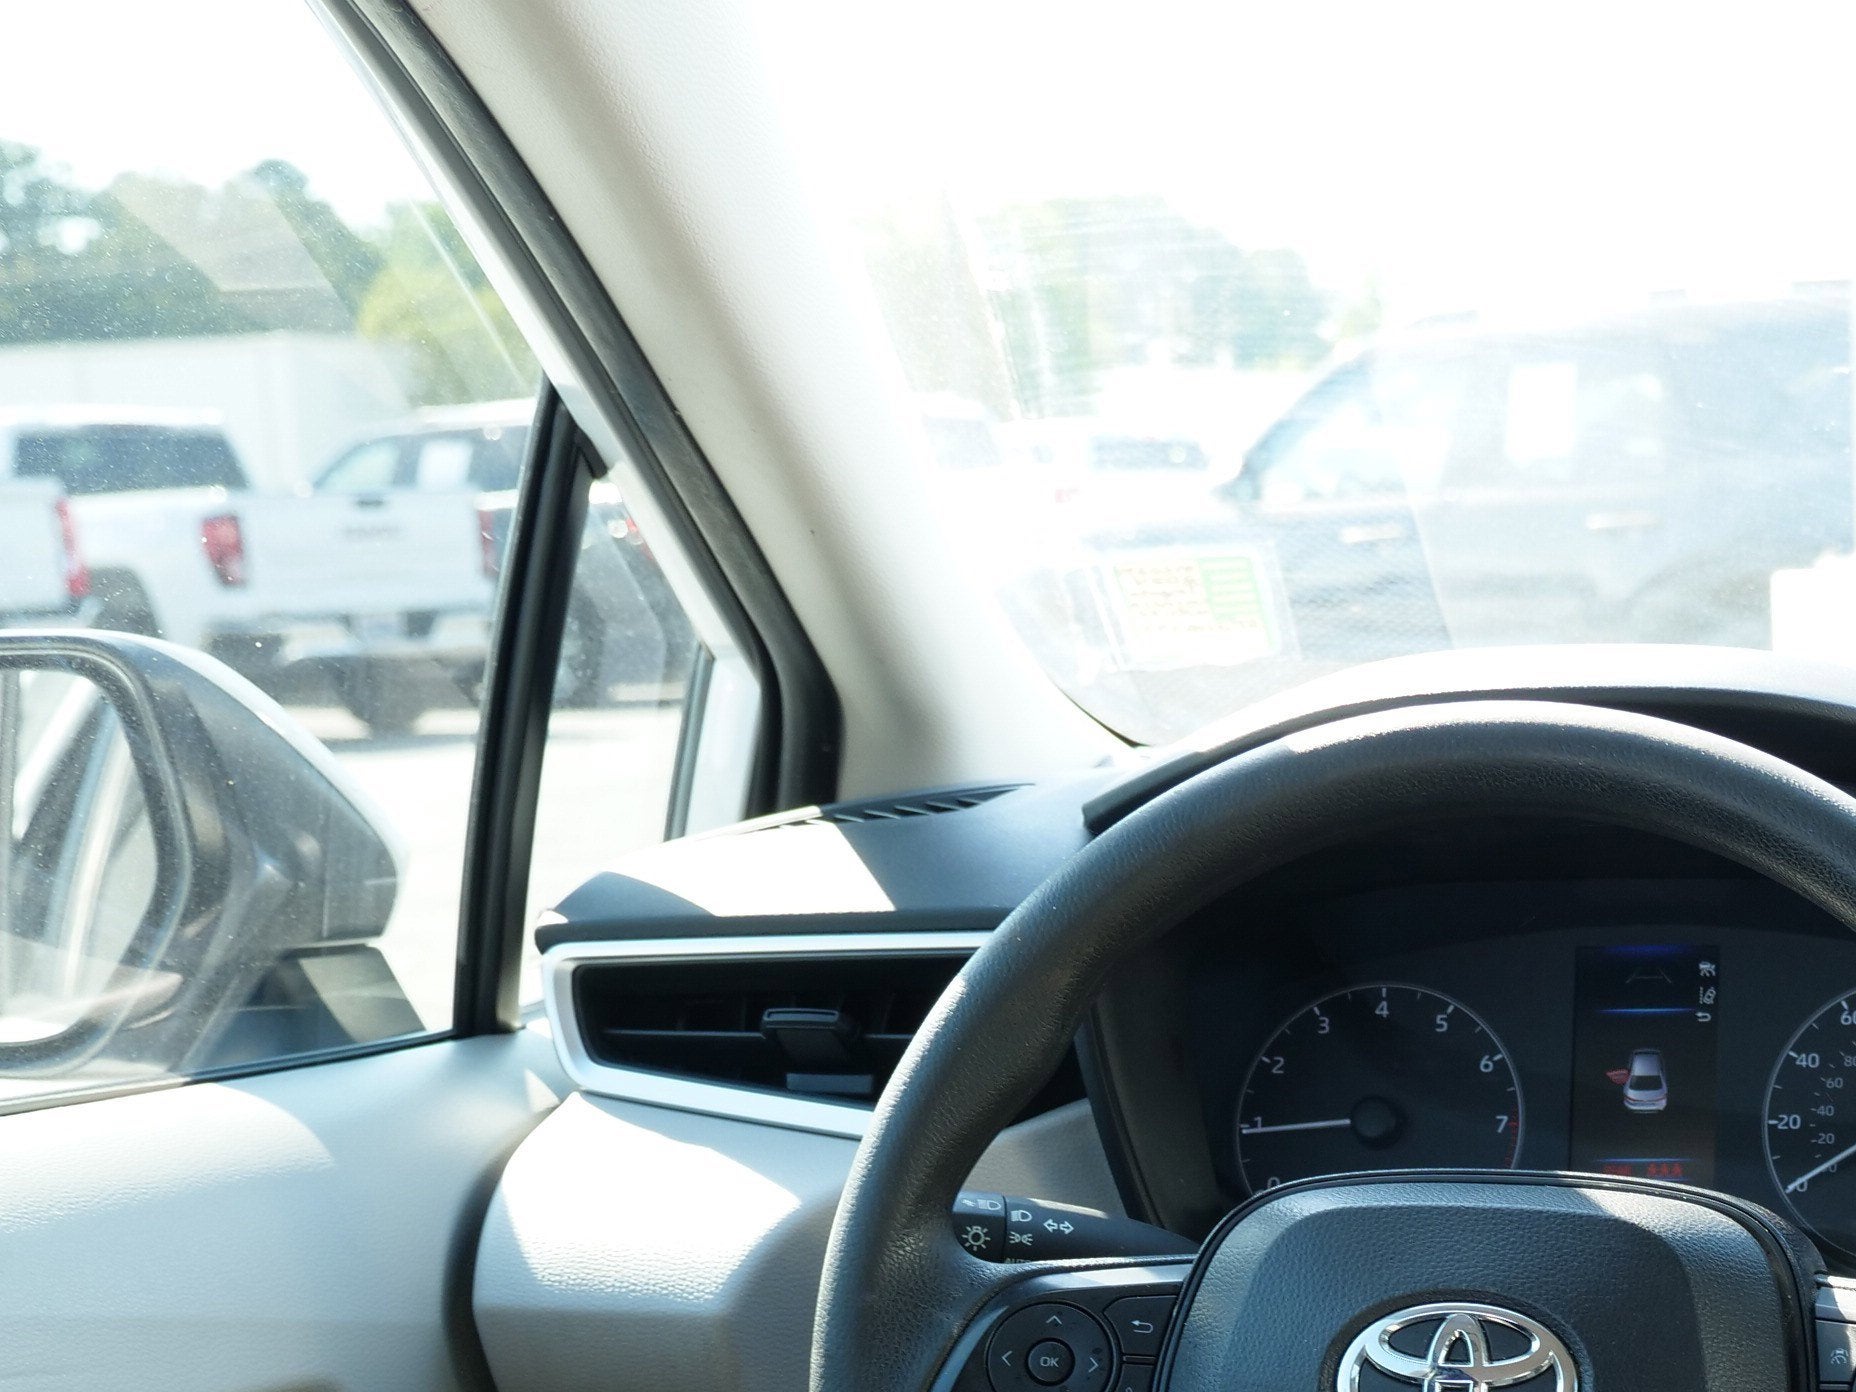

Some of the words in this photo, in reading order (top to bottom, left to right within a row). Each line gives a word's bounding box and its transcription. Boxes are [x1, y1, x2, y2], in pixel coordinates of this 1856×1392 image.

[1375, 1000, 1389, 1018] 4
[1317, 1017, 1331, 1034] 3
[1435, 1015, 1448, 1033] 5
[1271, 1057, 1285, 1074] 2
[1479, 1056, 1494, 1073] 6
[1795, 1053, 1820, 1068] 40
[1826, 1077, 1844, 1089] 60
[1816, 1105, 1835, 1117] 40
[1496, 1115, 1509, 1132] 7
[1777, 1114, 1801, 1130] 20
[1817, 1132, 1835, 1145] 20
[1039, 1356, 1060, 1368] OK
